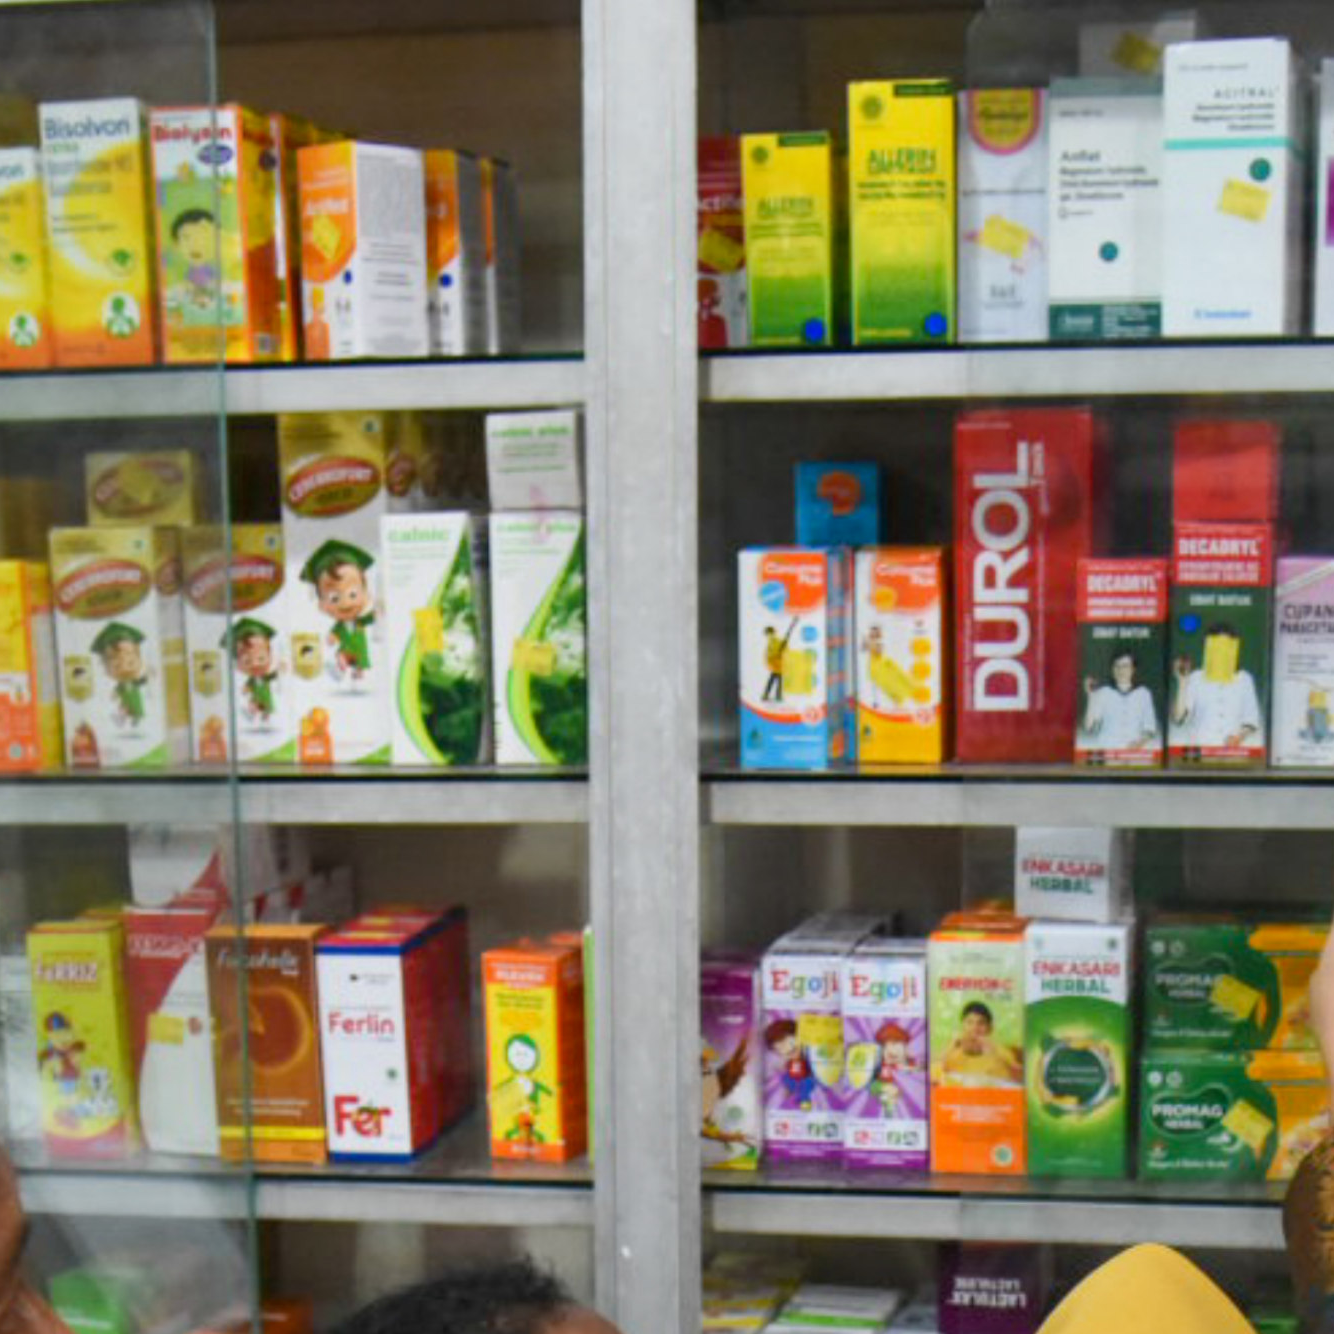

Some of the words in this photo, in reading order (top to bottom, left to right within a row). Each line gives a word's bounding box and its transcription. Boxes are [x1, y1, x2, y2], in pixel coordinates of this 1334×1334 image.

[44, 116, 131, 140] Bisolvon
[971, 440, 1030, 712] DUROL
[1022, 858, 1106, 878] ENKASARI
[1029, 877, 1094, 894] HERBAL
[1031, 959, 1121, 977] ENKASARI
[771, 969, 839, 999] Egoji
[850, 974, 918, 1004] Egoji
[1040, 978, 1110, 995] HERBAL
[327, 1010, 396, 1035] Ferlin
[333, 1094, 393, 1139] Fer
[1151, 1104, 1224, 1118] PROMAG
